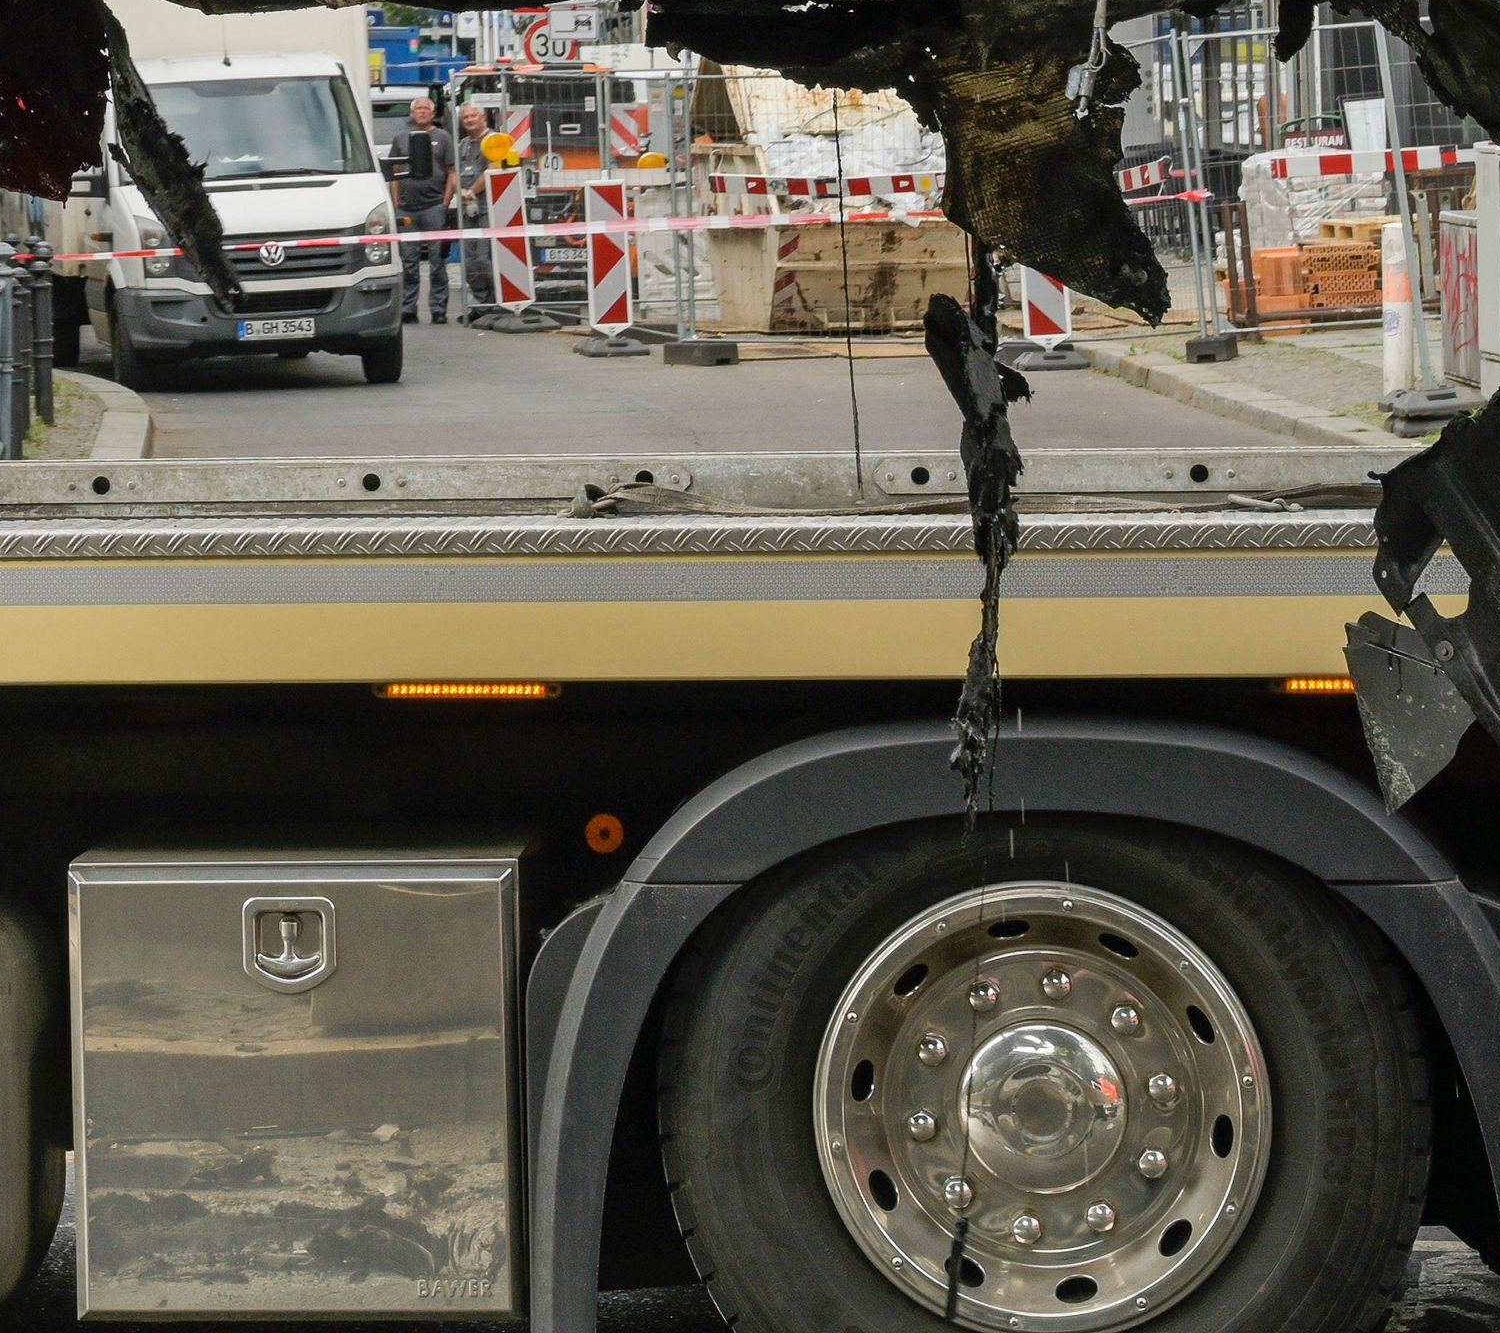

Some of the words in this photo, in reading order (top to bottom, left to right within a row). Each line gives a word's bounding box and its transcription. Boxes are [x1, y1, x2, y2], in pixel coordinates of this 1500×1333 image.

[535, 33, 566, 57] 30
[544, 156, 559, 171] 40
[245, 323, 253, 335] B
[262, 322, 279, 334] GH
[281, 320, 312, 333] 3543
[730, 859, 880, 1093] Continental
[417, 1278, 493, 1299] BAWER
